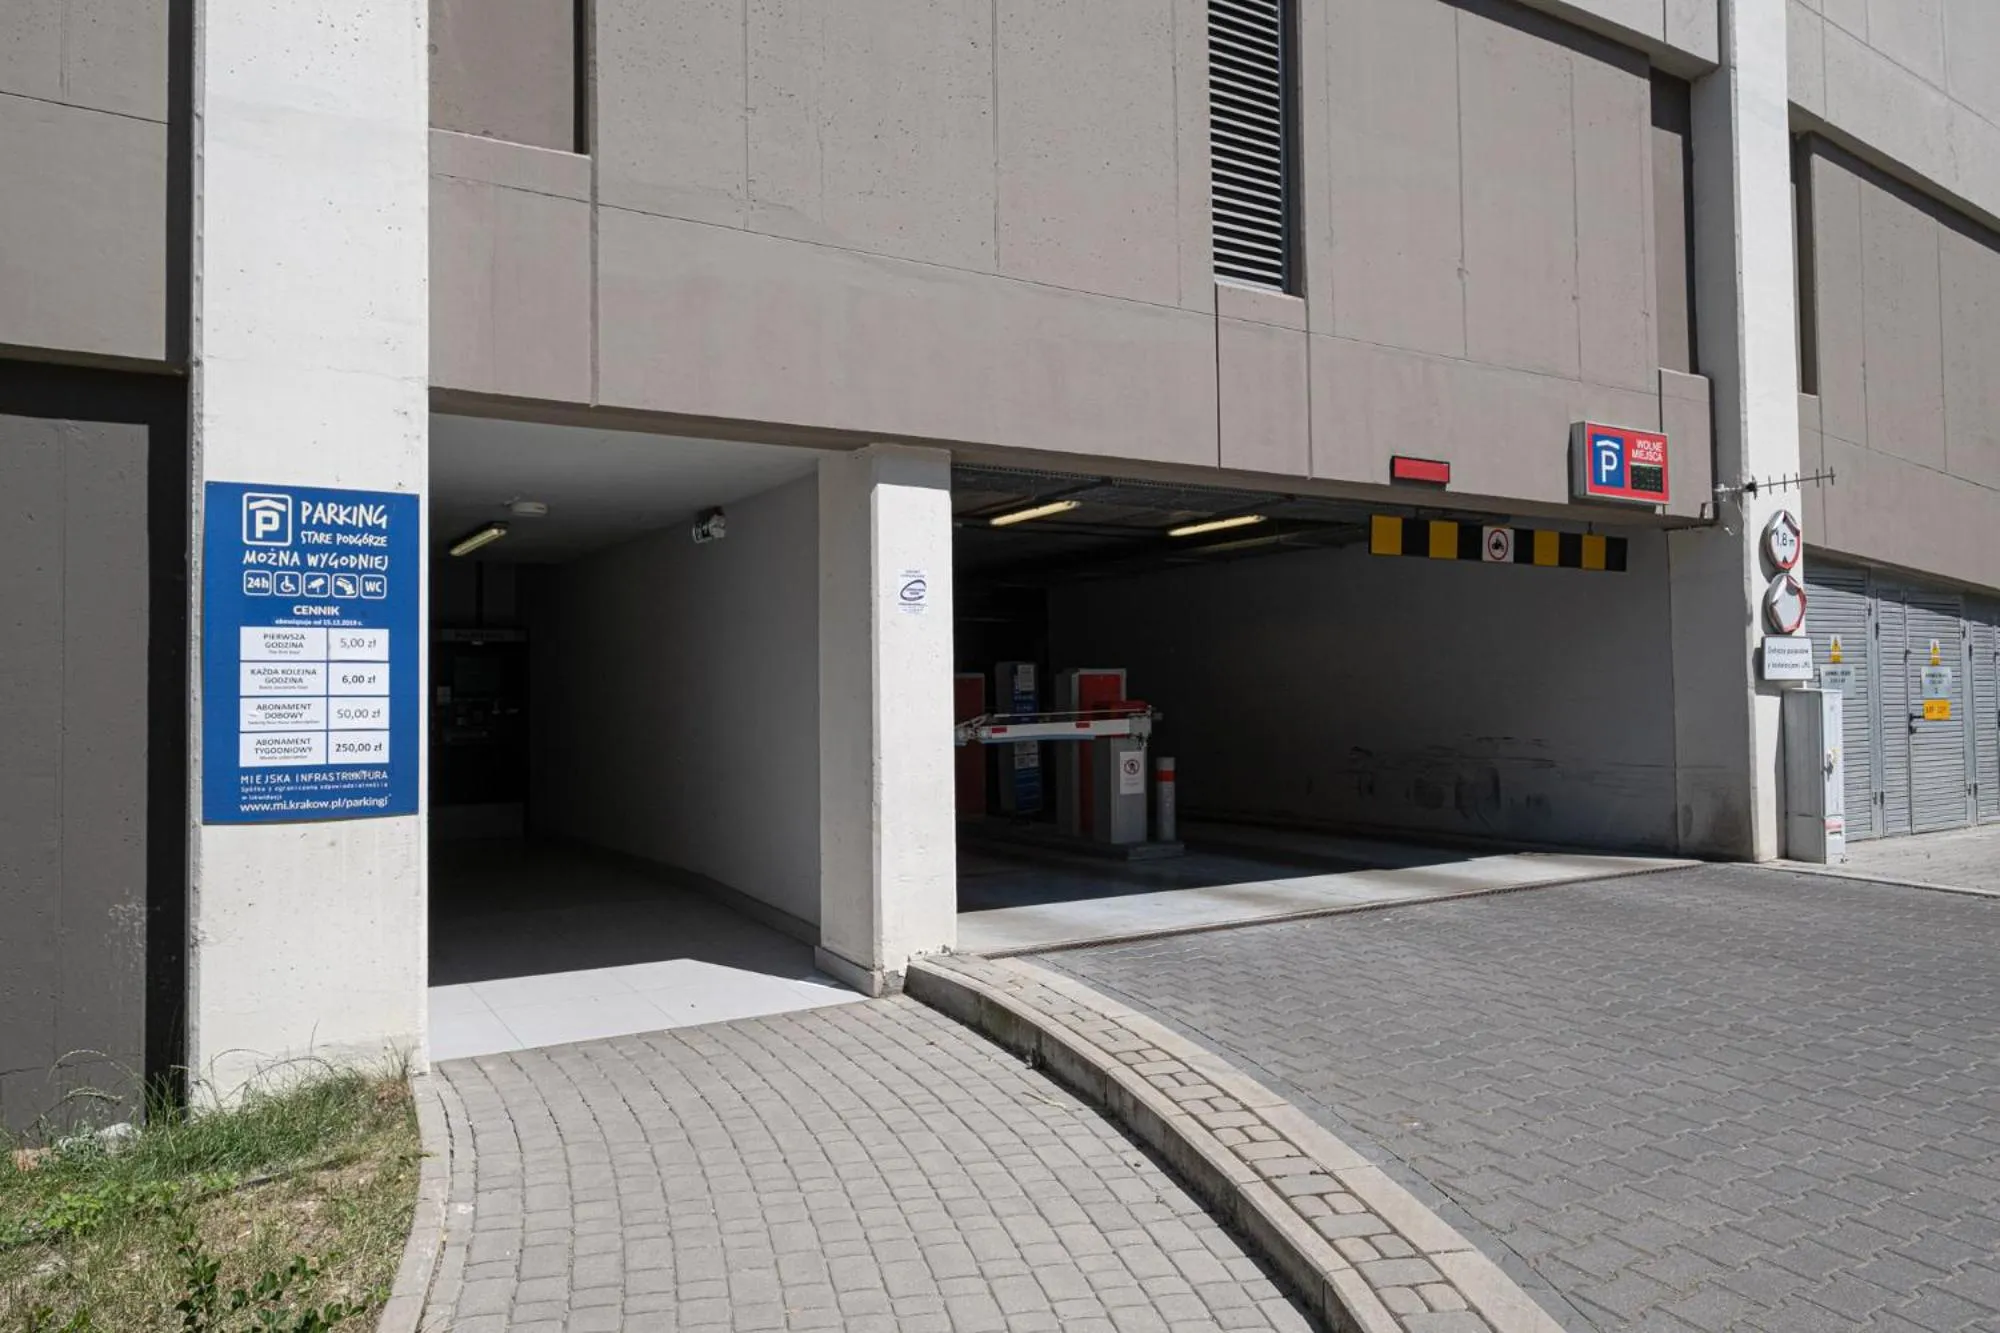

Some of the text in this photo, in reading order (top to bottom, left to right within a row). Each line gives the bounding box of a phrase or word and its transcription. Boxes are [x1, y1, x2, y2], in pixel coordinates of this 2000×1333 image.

[1636, 439, 1663, 453] WOLNE
[1631, 448, 1663, 462] MIEJSCA
[1601, 450, 1618, 483] P
[300, 501, 388, 529] PARKING
[255, 509, 280, 540] P
[300, 530, 388, 547] STARE PODGÓRZE
[242, 547, 389, 571] MOŻNA WYGODNIEJ
[246, 576, 270, 589] 24h
[364, 580, 382, 593] WC
[292, 604, 340, 616] CENNIK
[263, 633, 306, 641] PIERWSZA
[264, 641, 304, 649] GODZINA
[340, 638, 377, 649] 5,00 zł
[250, 667, 317, 676] KAŻDA KOLEJNA
[264, 676, 304, 684] GODZINA
[342, 675, 377, 685] 6,00 zł
[256, 703, 312, 711] ABONAMENT
[264, 711, 304, 719] DOBOWY
[336, 708, 381, 720] 50,00 zł
[255, 738, 311, 746] ABONAMENT
[335, 743, 383, 753] 250,00 zł
[254, 746, 313, 755] TYGODNIOWY
[240, 770, 388, 784] MIEJSKA INFRASTRUKTURA
[239, 796, 389, 812] www.mi.krakow.pl/parkingi
